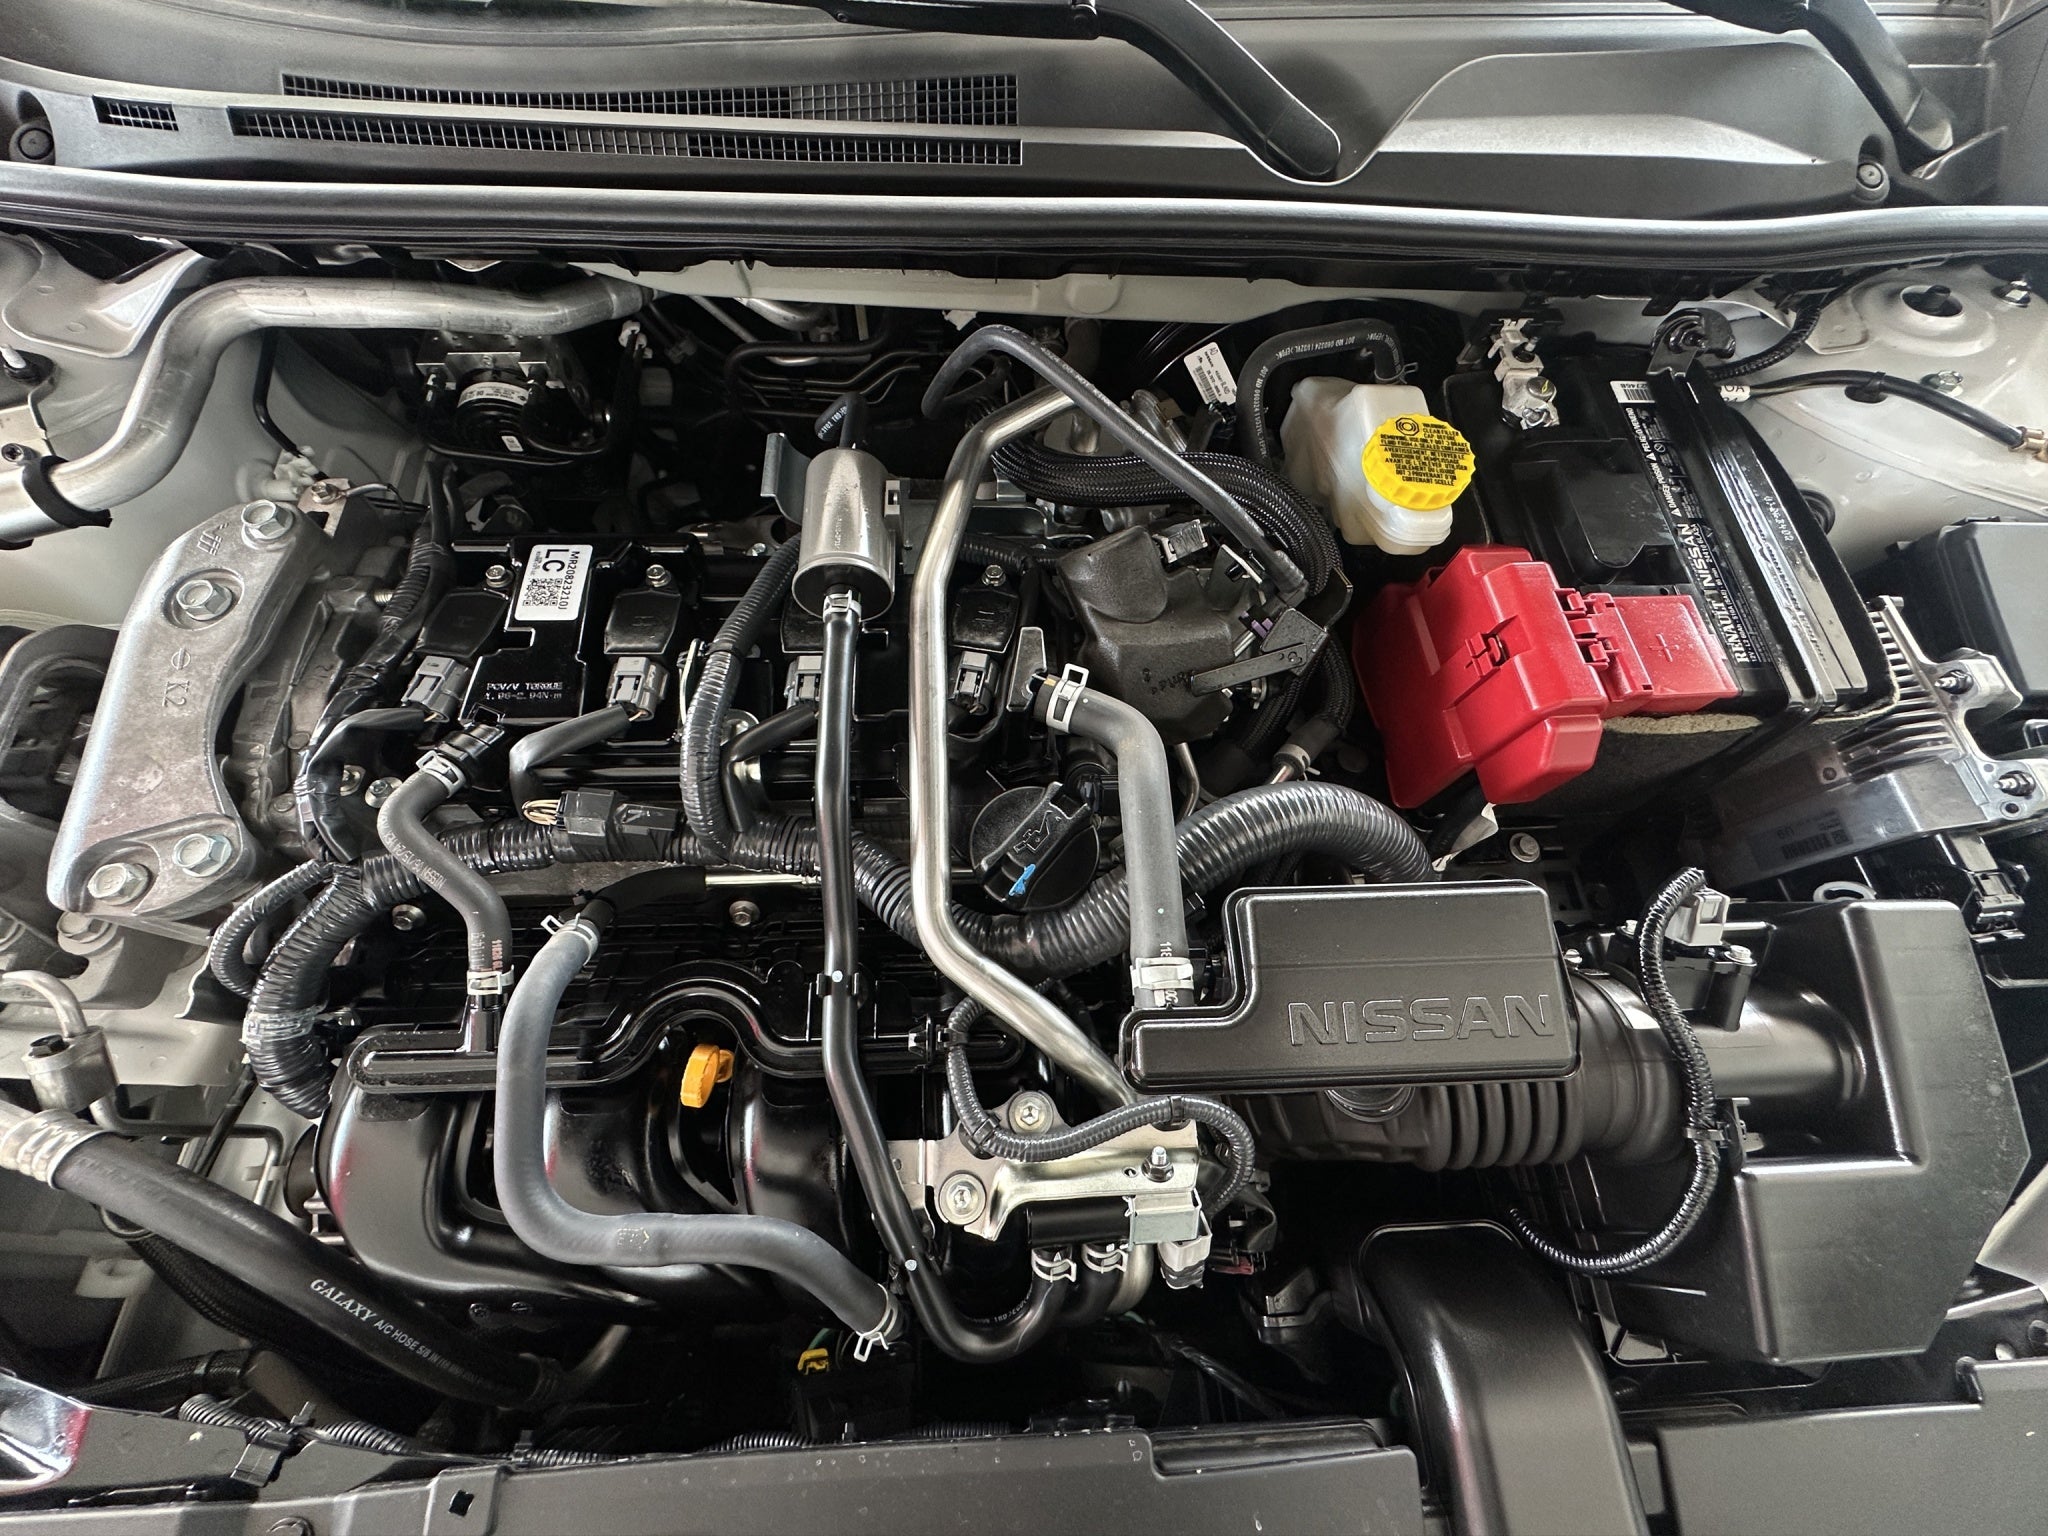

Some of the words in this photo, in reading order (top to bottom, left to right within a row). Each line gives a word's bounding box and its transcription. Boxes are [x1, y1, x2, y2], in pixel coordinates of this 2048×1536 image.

[542, 549, 569, 572] LC
[558, 551, 580, 610] MR20823210J
[1678, 524, 1716, 588] NISSAN
[1711, 599, 1750, 663] RENAULT
[525, 682, 563, 690] TORQUE
[1287, 993, 1554, 1046] NISSAN
[310, 1279, 377, 1322] GALAXY
[374, 1319, 394, 1335] A/C
[391, 1329, 418, 1351] HOSE
